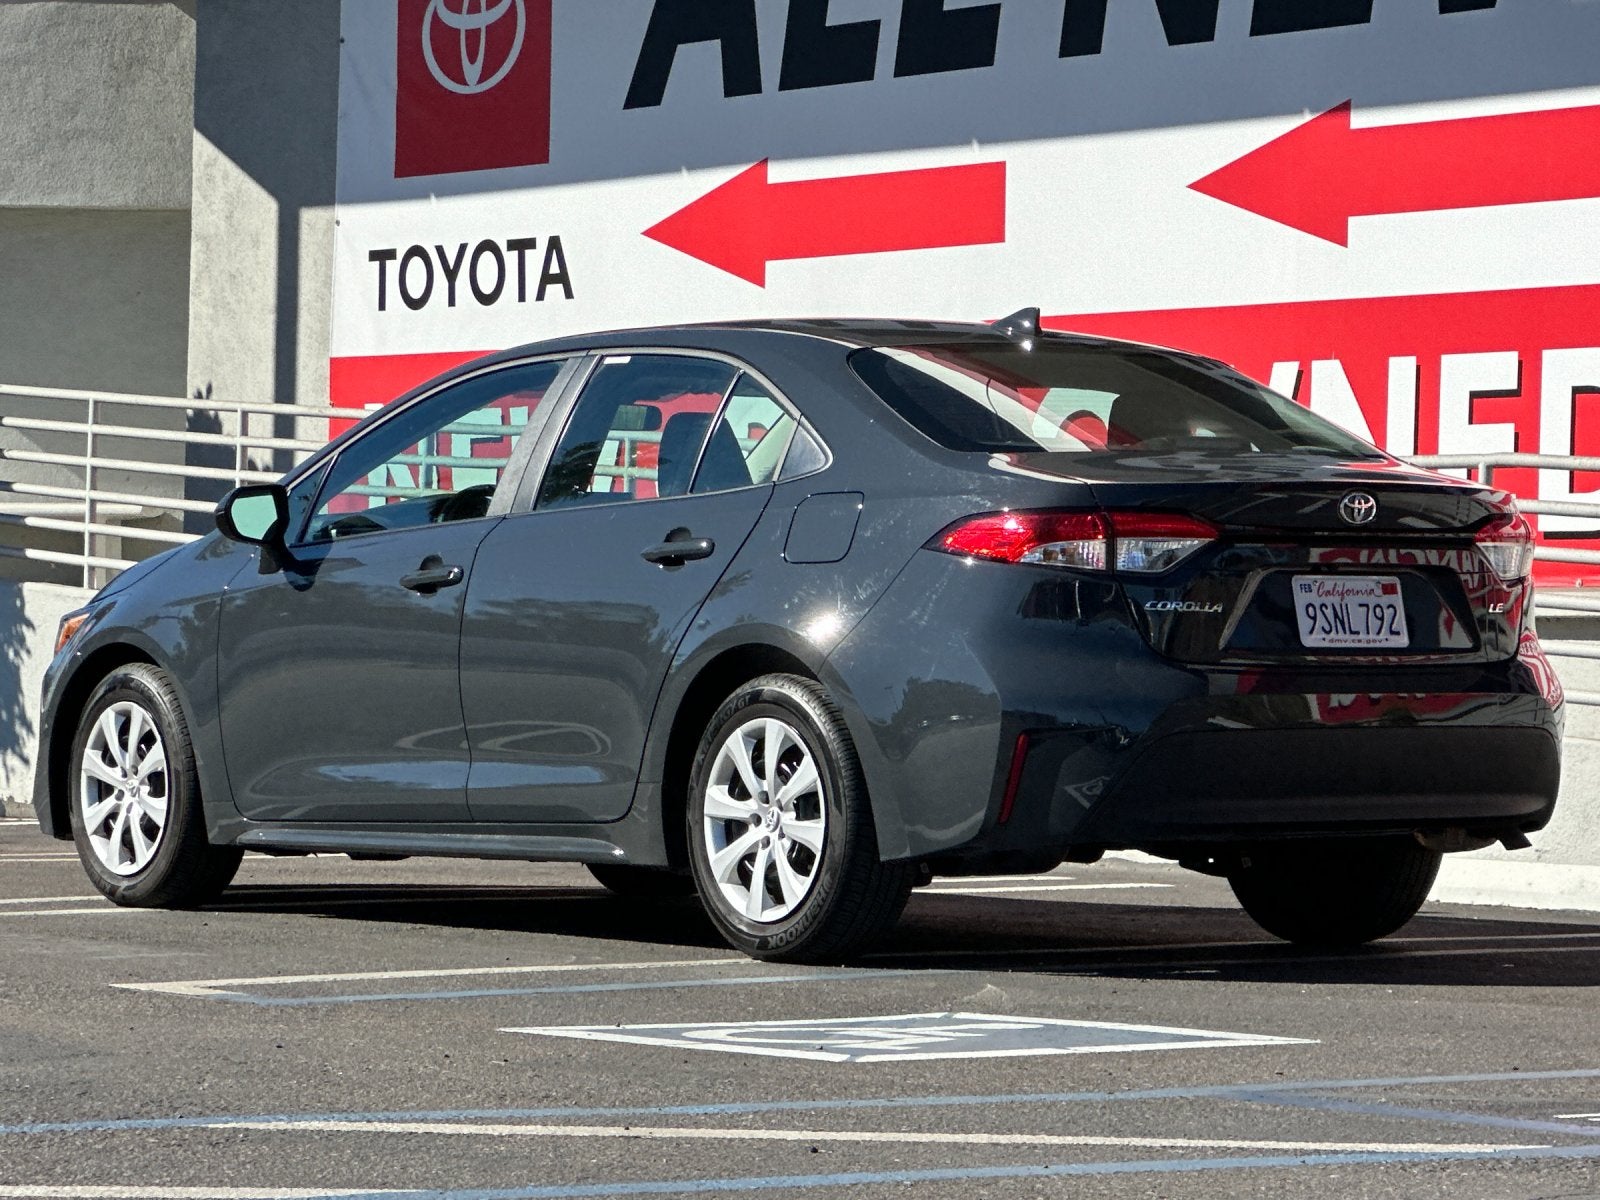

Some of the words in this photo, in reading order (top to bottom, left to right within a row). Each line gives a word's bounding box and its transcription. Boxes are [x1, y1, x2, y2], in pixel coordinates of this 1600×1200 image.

[368, 235, 575, 312] TOYOTA
[1299, 583, 1313, 594] FEB
[1316, 580, 1377, 602] California
[1144, 600, 1223, 614] COROLLA
[1488, 602, 1504, 614] LE
[1305, 602, 1401, 636] 9SNL792
